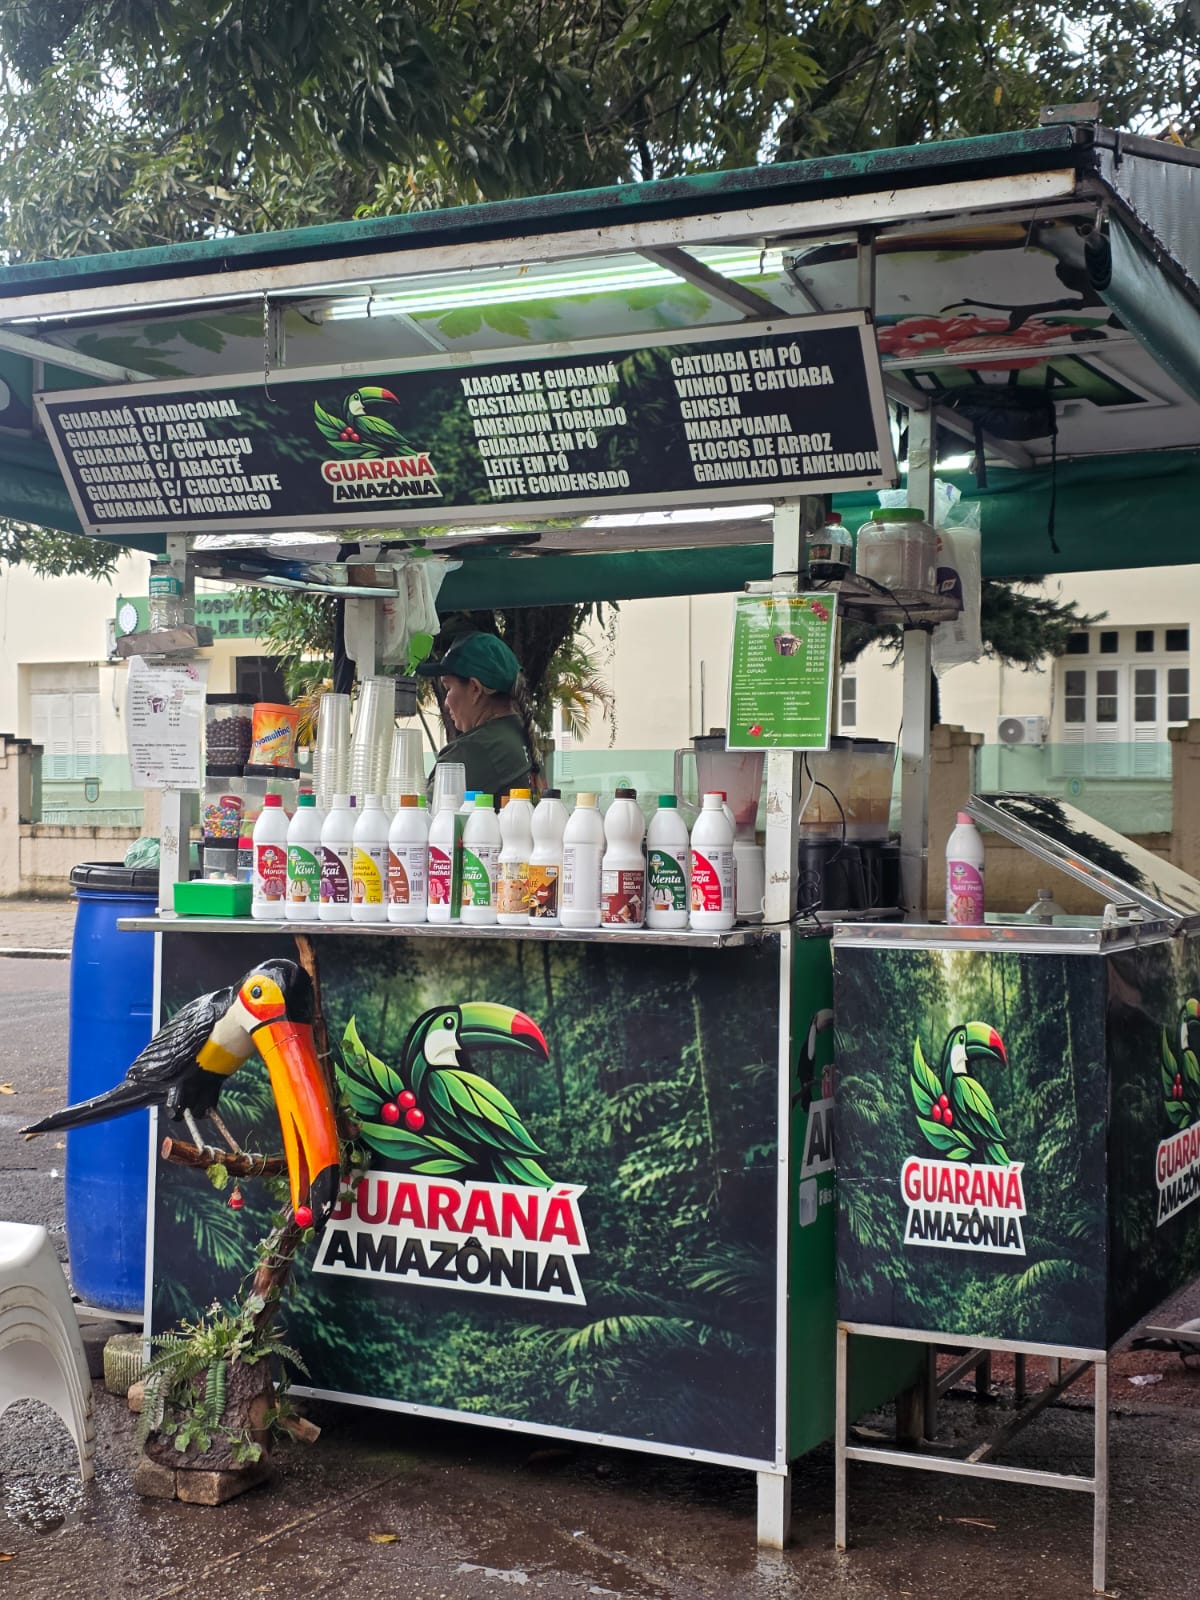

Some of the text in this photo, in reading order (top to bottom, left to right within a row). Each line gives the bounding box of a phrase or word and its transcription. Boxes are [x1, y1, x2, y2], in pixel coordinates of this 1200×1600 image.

[670, 341, 802, 377] CATUABA EM PÓ
[460, 361, 620, 396] XAROPE DE GUARANÁ
[674, 365, 834, 398] VINHO DE CATUABA
[58, 399, 241, 430] GUARANÁ TRADICONAL
[467, 386, 611, 417] CASTANHA DE CAJU
[680, 396, 741, 420] GINSEN
[472, 406, 627, 437] AMENDOIN TORRADO
[684, 414, 792, 440] MARAPUAMA
[65, 425, 143, 448] GUARANÁ
[143, 425, 162, 443] C/
[477, 427, 599, 457] GUARANÁ EM PÓ
[688, 432, 833, 461] FLOCOS DE ARROZ
[73, 443, 149, 466] GUARANÁ
[150, 443, 169, 461] C/
[482, 450, 570, 478] LEITE EM PÓ
[79, 462, 154, 484] GUARANÁ
[156, 461, 175, 479] C/
[323, 456, 436, 482] GUARANÁ
[693, 458, 779, 483] GRANULAZO
[780, 456, 801, 476] DE
[86, 474, 282, 502] GUARANÁ C/ CHOCOLATE
[335, 479, 438, 500] AMAZÔNIA
[488, 469, 631, 498] LEITE CONDENSADO
[92, 493, 272, 519] GUARANÁ C/MORANGO
[294, 864, 316, 875] Kiwi
[321, 864, 341, 877] Açaí
[650, 873, 682, 884] Menta
[904, 1162, 1023, 1210] GUARANÁ
[908, 1207, 1021, 1249] AMAZÔNIA
[322, 1229, 577, 1296] AMAZÔNIA
